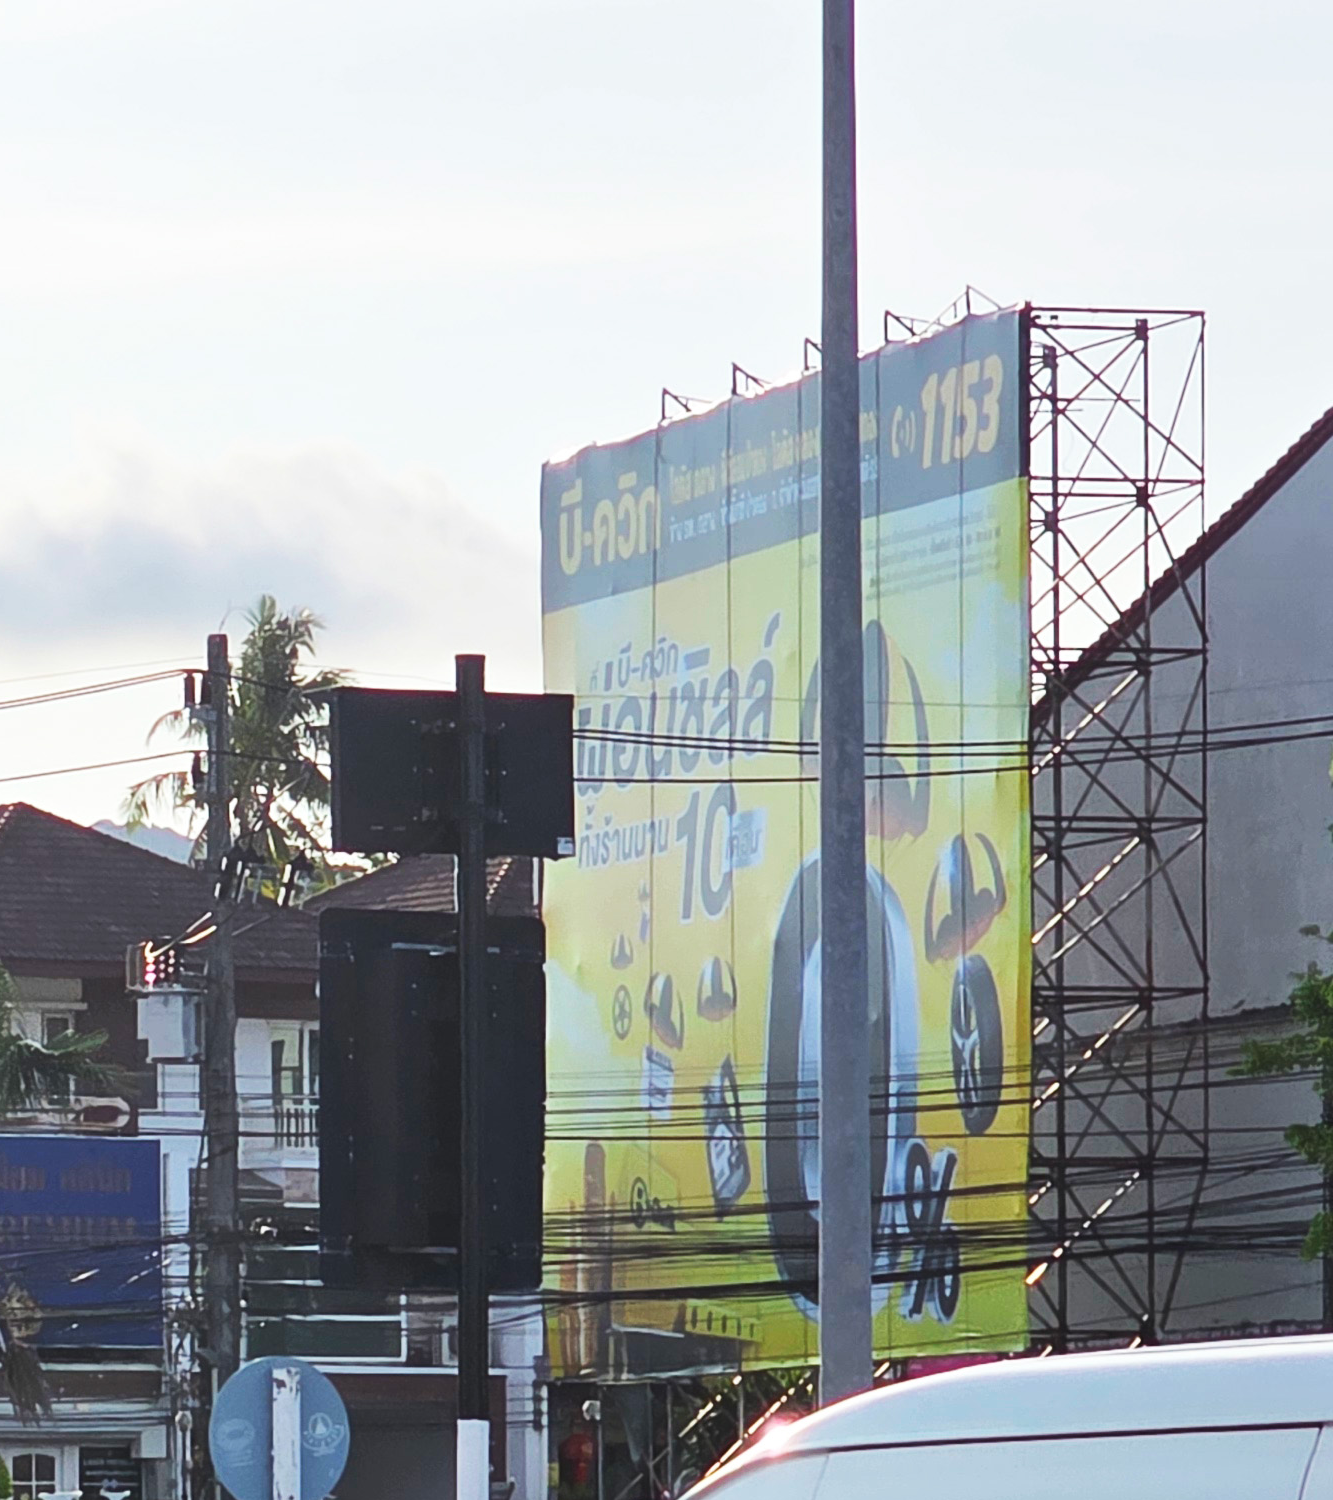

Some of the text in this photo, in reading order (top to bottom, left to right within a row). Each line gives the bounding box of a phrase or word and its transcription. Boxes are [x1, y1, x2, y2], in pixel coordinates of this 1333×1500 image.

[920, 354, 1003, 469] 1153
[558, 471, 662, 576] บี-ควิก
[675, 783, 737, 922] 10
